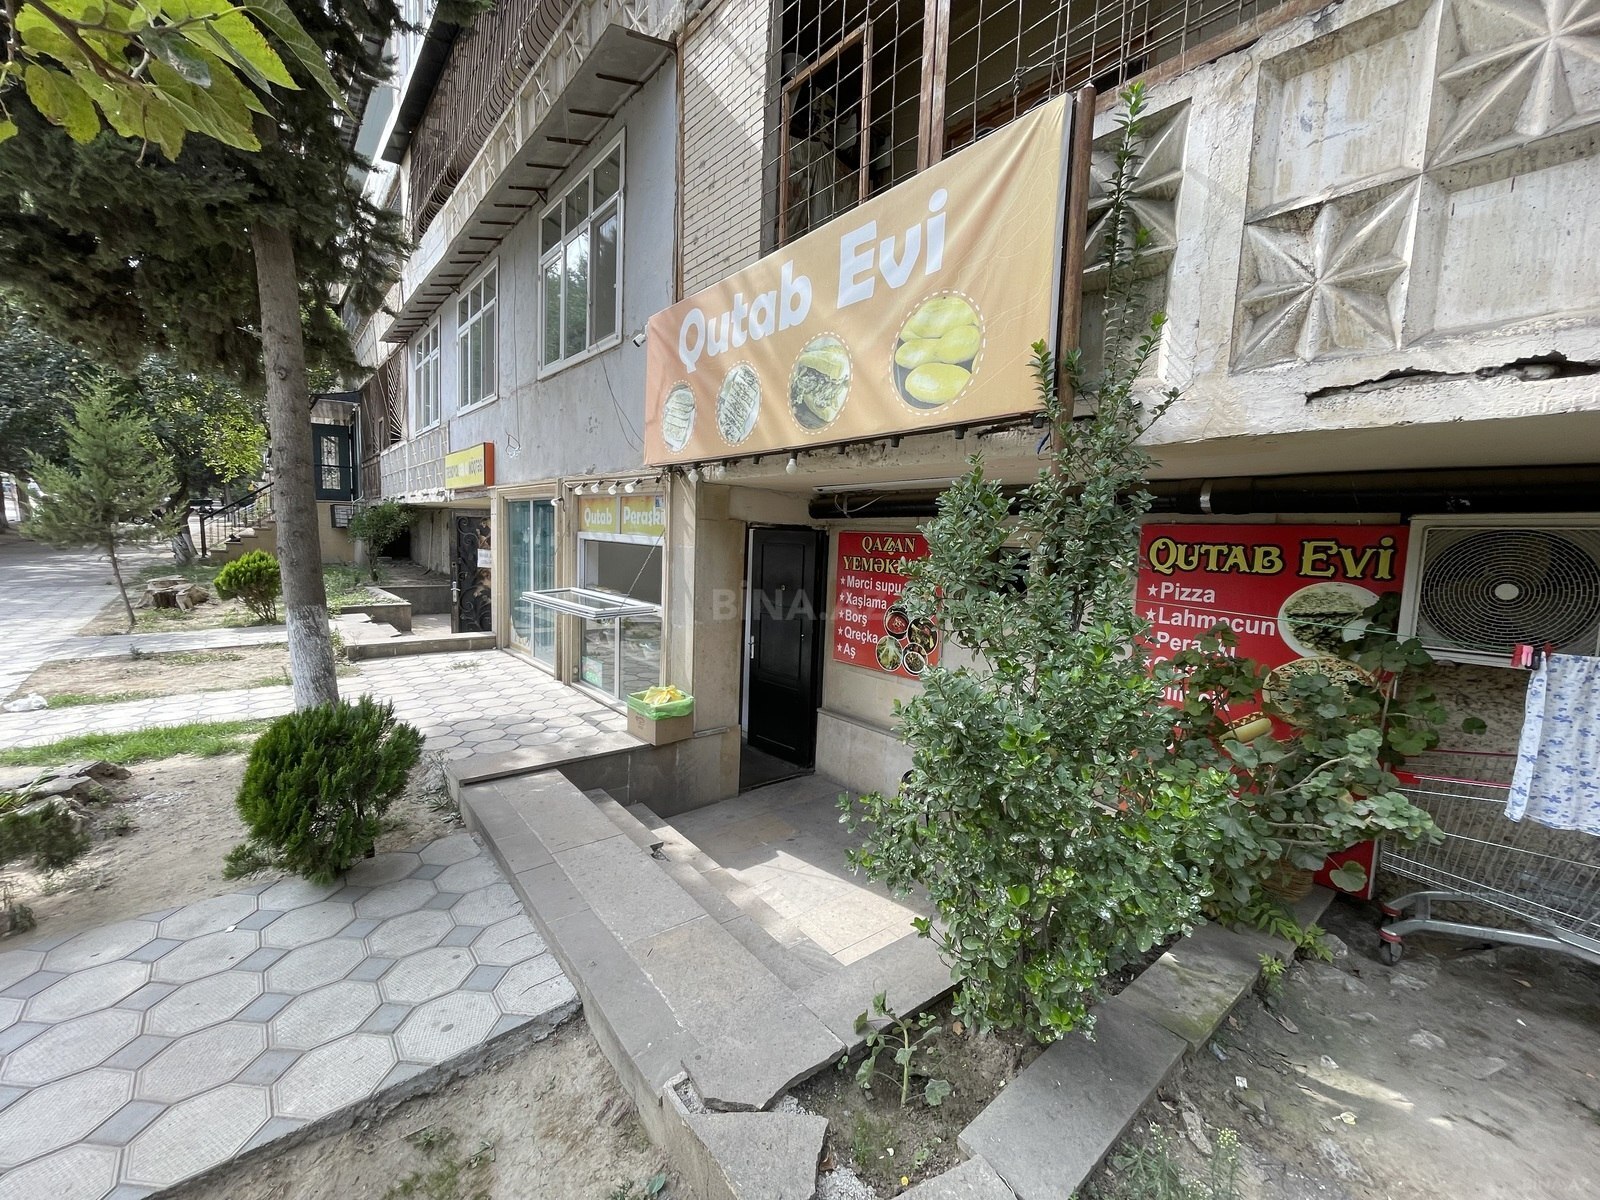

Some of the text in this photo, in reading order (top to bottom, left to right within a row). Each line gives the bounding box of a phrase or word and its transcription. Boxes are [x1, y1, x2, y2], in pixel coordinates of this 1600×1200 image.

[678, 188, 948, 373] Qutab Evi
[584, 507, 612, 527] Qutab
[861, 536, 916, 554] QAZAN
[843, 555, 912, 575] YEMƏK
[1149, 538, 1283, 575] QUTAB
[846, 576, 873, 590] Mərci
[1160, 582, 1215, 603] Pizza
[846, 592, 887, 609] Xaşlama
[845, 610, 868, 627] Borş
[844, 627, 878, 644] Qreçka
[1157, 632, 1236, 658] Pera
[843, 643, 856, 659] Aş
